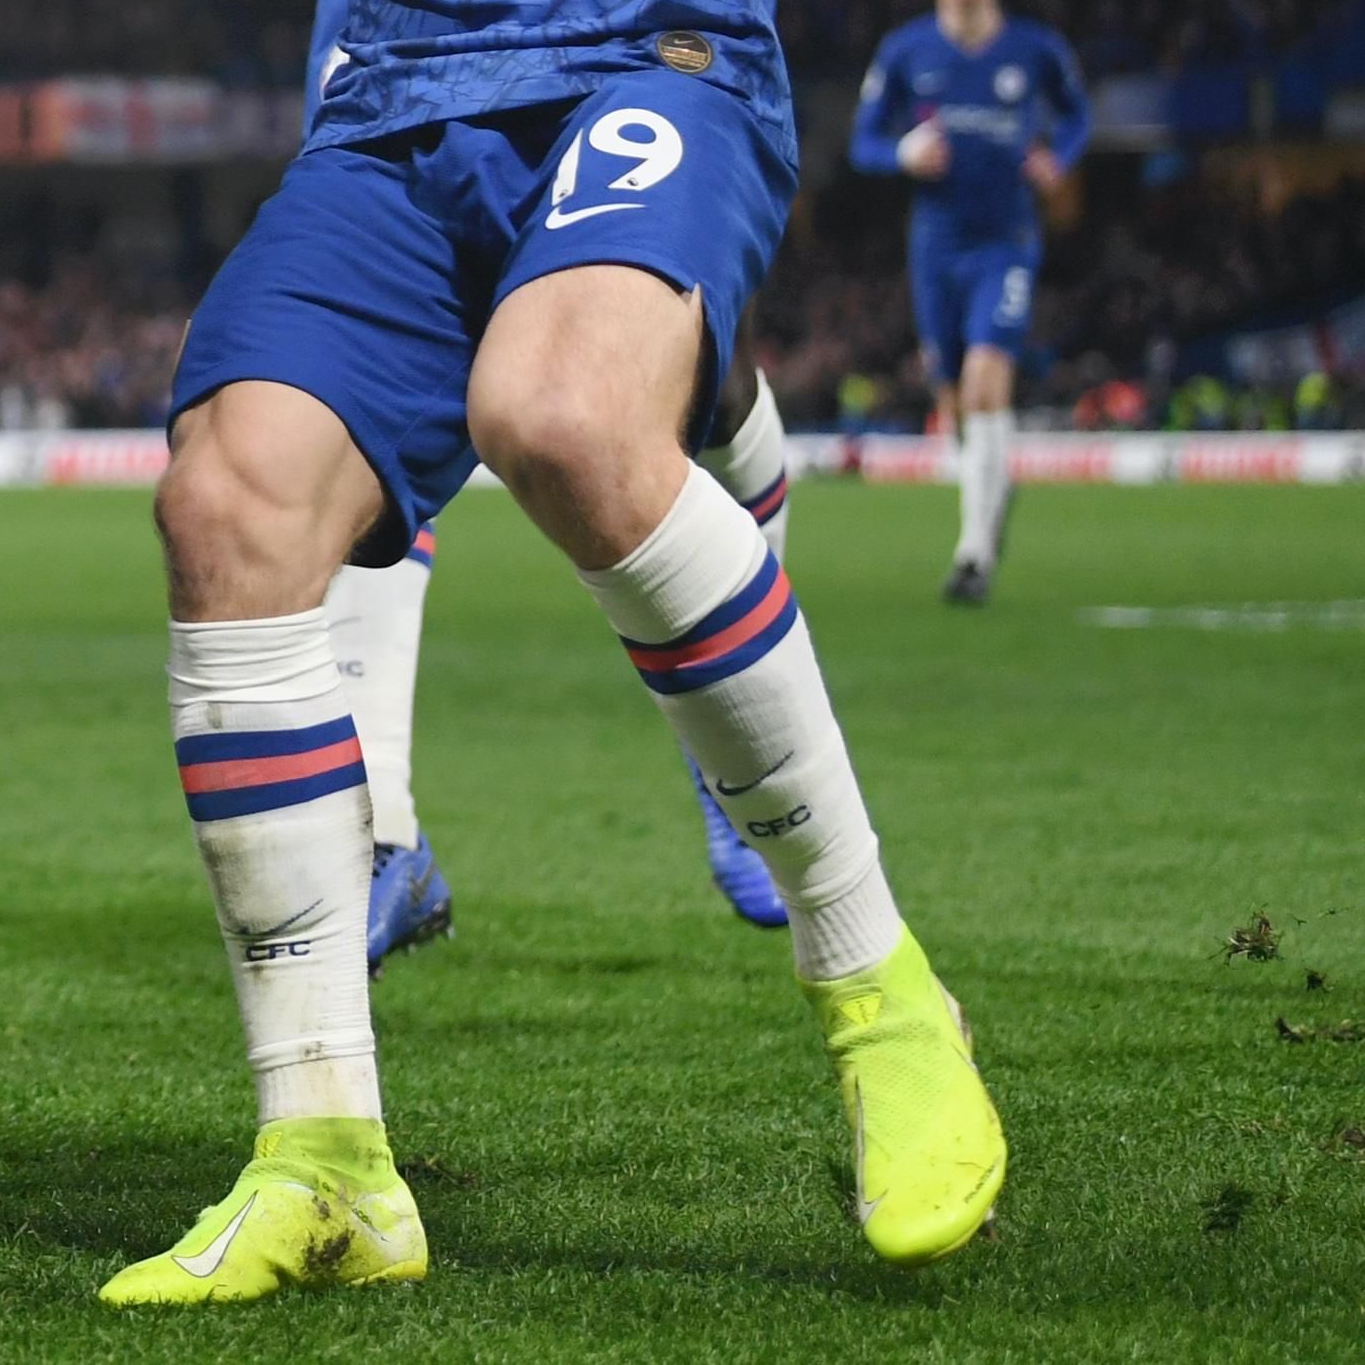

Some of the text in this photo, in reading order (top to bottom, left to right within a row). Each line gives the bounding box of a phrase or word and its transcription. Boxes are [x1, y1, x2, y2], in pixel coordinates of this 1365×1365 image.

[551, 108, 684, 207] 19
[746, 803, 812, 838] CFC
[245, 939, 311, 962] CFC
